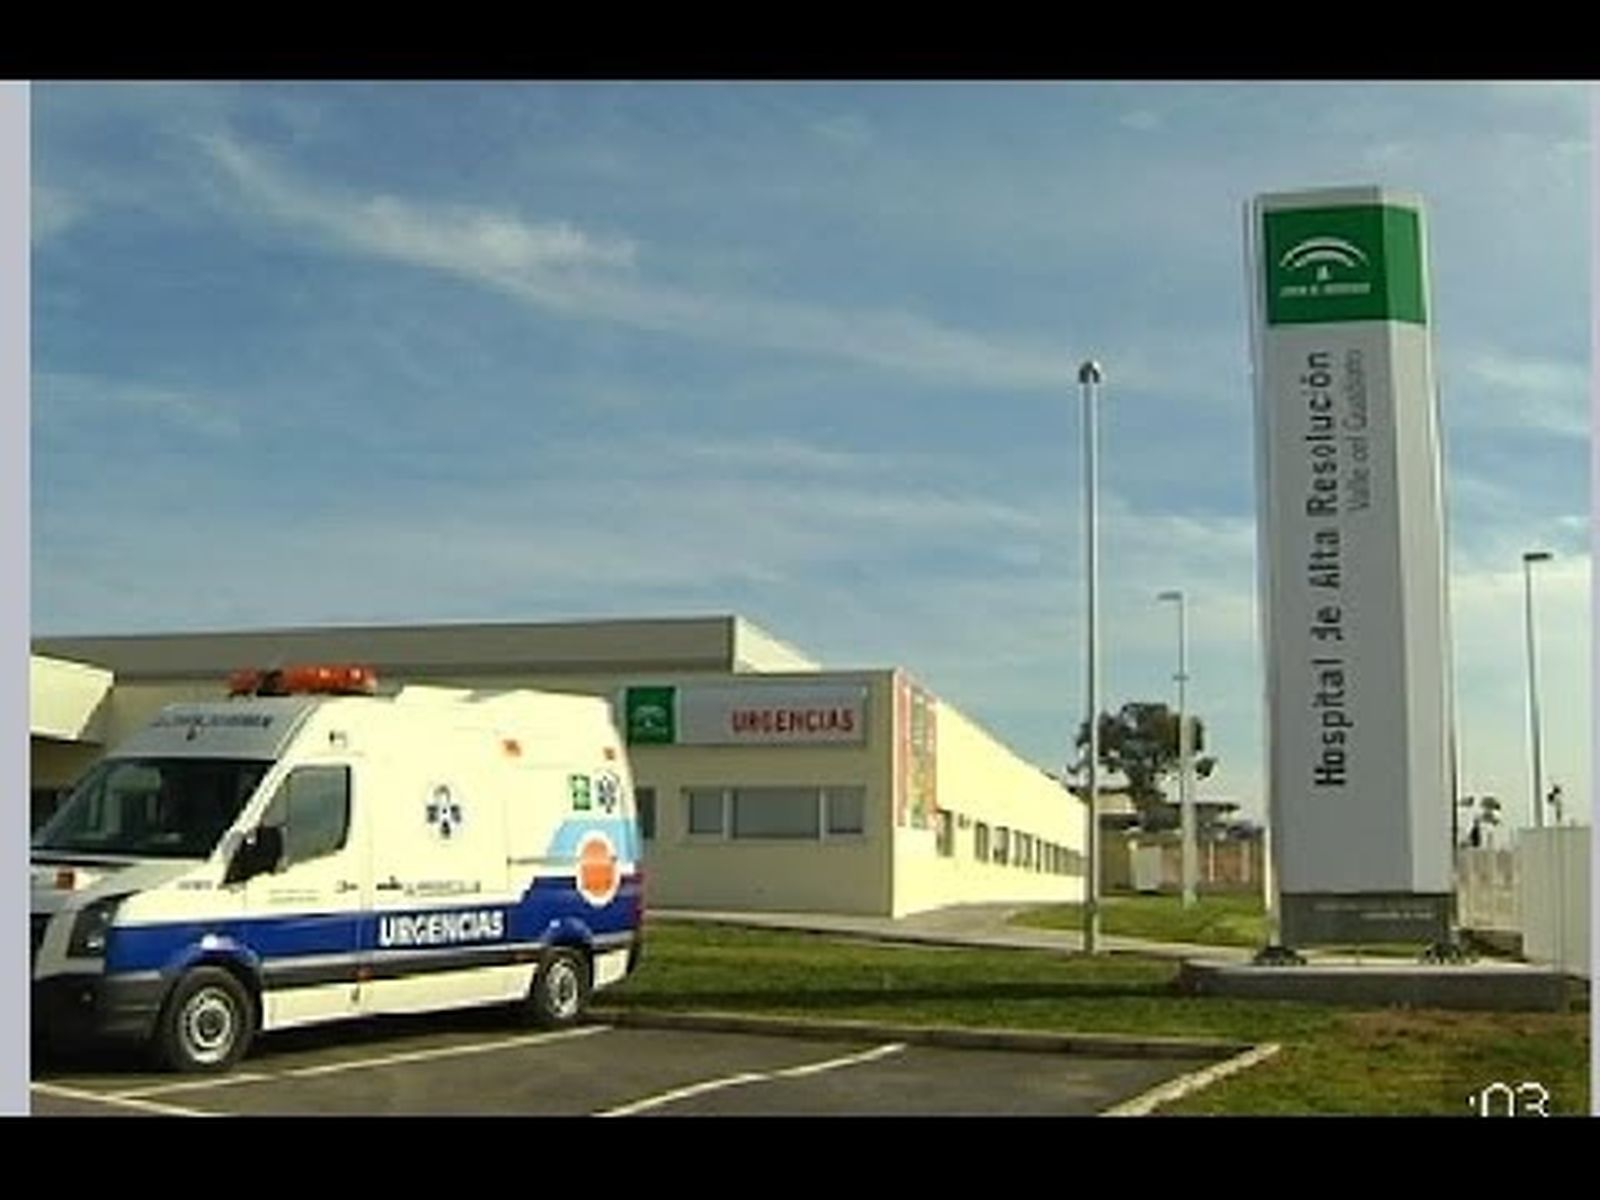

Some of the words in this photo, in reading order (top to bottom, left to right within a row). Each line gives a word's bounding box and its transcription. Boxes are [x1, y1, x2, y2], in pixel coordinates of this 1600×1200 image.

[1308, 530, 1341, 589] Alta
[1310, 605, 1344, 642] de
[731, 707, 856, 734] URGENCIAS
[1312, 654, 1354, 786] Hospital
[378, 909, 505, 948] URGENCIAS
